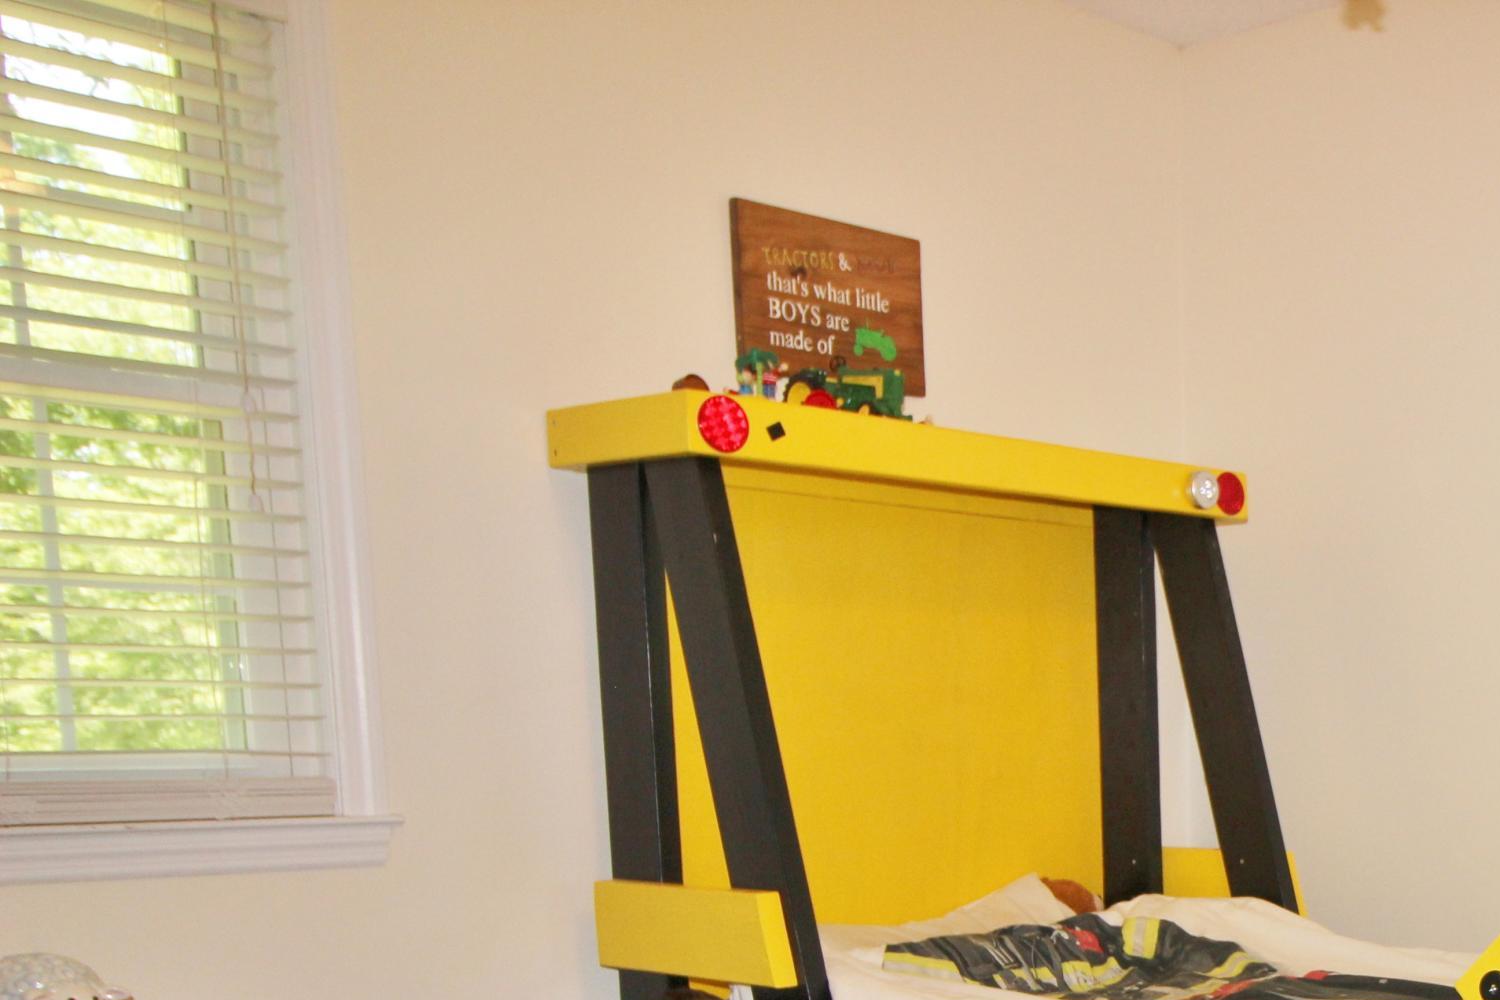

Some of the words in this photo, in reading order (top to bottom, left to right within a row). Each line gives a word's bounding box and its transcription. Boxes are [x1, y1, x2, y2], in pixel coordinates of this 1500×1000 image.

[761, 247, 834, 271] TRACTORS
[838, 251, 852, 272] &
[766, 269, 809, 298] that's
[813, 281, 851, 306] what
[856, 287, 890, 314] little
[767, 296, 822, 327] BOYS
[826, 312, 851, 332] are
[769, 329, 813, 352] made
[817, 334, 836, 355] of
